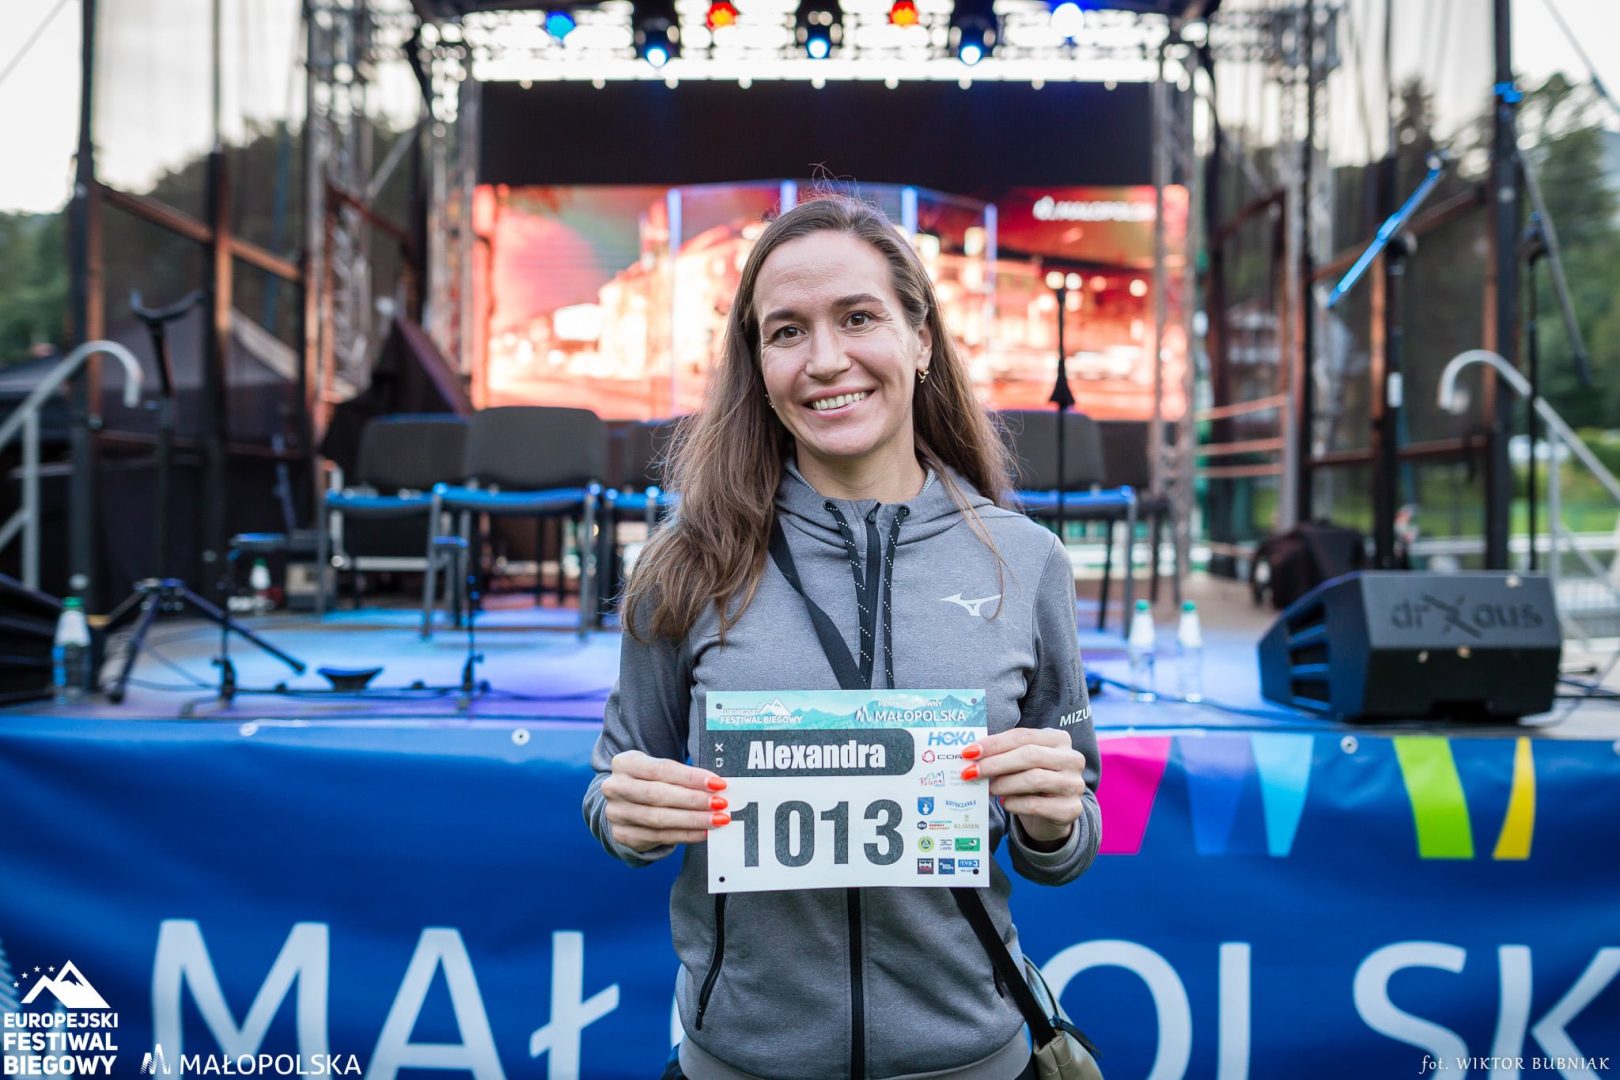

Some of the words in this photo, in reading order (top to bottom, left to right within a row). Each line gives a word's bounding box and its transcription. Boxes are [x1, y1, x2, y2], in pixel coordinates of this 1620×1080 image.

[720, 716, 762, 725] FESTIWAL
[764, 715, 803, 724] BIEGOWY
[875, 709, 967, 722] MAŁOPOLSKA
[1060, 705, 1092, 727] MIZU
[927, 731, 976, 746] HOKA
[747, 740, 886, 770] Alexandra
[730, 799, 904, 868] 1013
